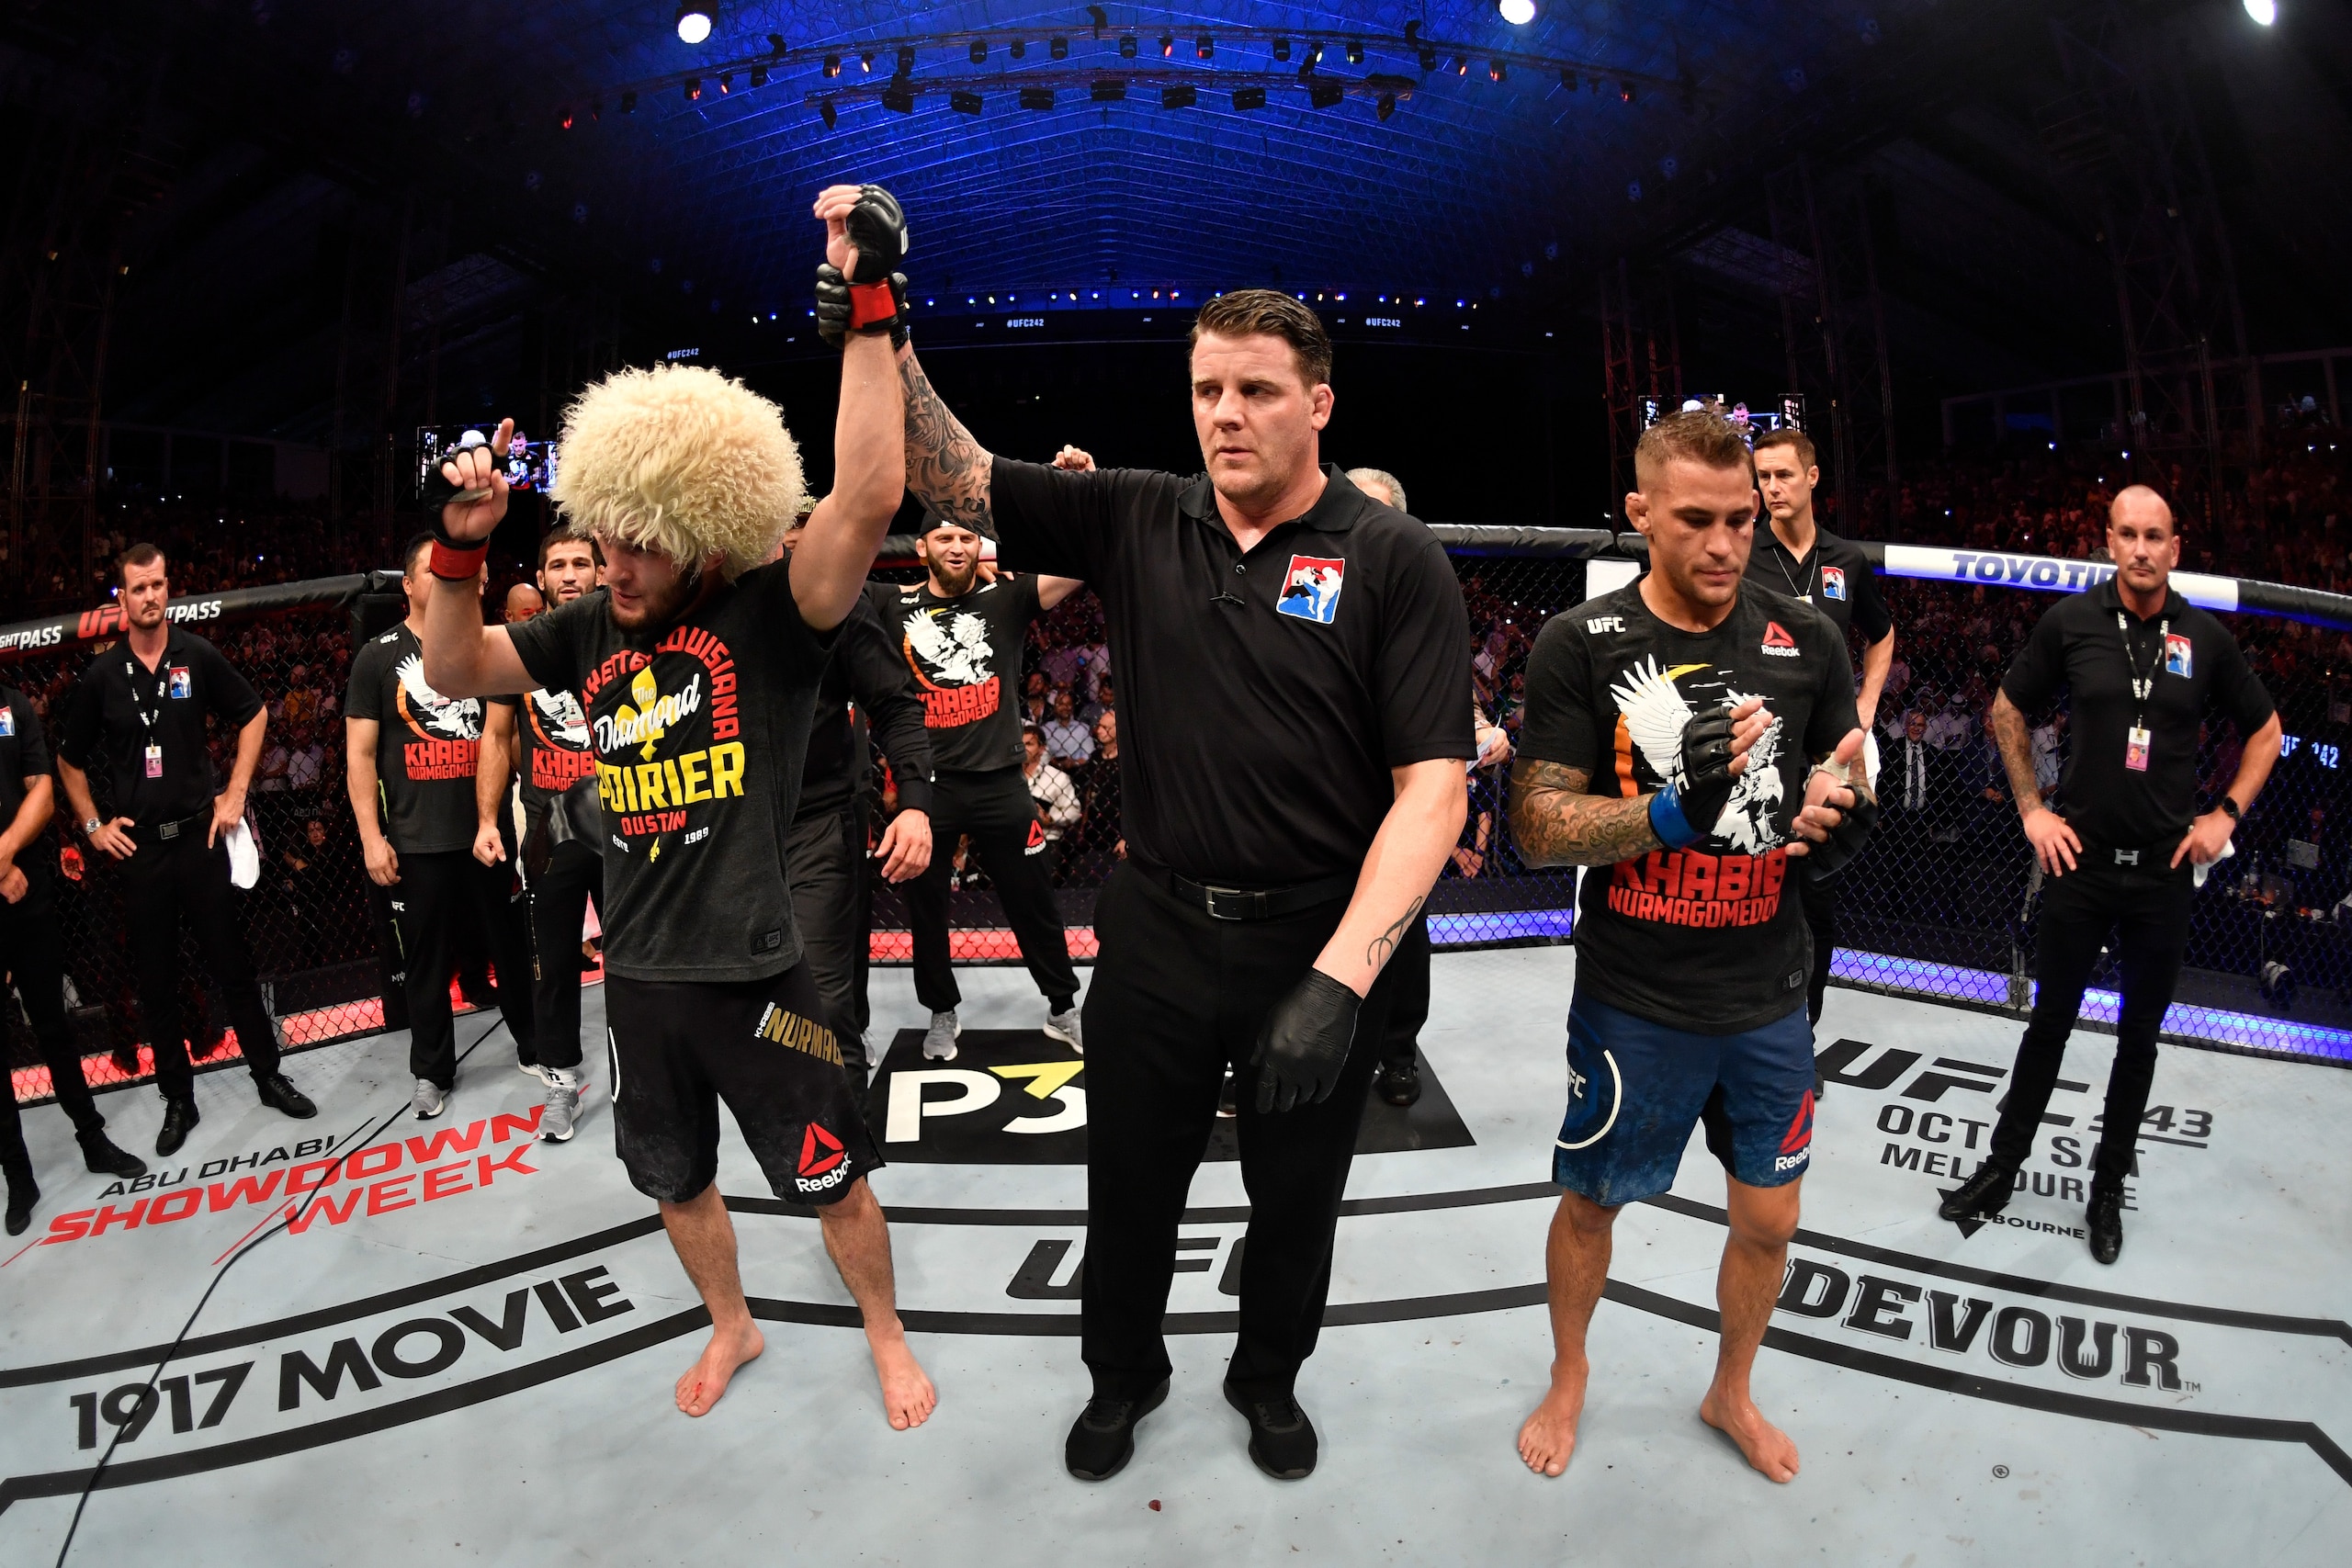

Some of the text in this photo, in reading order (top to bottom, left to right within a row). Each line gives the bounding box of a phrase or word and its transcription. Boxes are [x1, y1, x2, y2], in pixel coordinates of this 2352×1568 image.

[1007, 319, 1045, 328] #UFC242
[1365, 318, 1401, 327] #UFC242
[667, 347, 699, 360] #UFC242
[1952, 553, 2060, 586] TOYO
[1587, 616, 1626, 635] UFC
[1760, 644, 1801, 657] Reebok
[593, 672, 700, 754] Diamond
[634, 684, 655, 705] The
[594, 741, 745, 812] POIRIER
[621, 810, 687, 836] DUSTIN
[684, 827, 709, 844] 1989
[1612, 847, 1786, 902] KHABIB
[1608, 885, 1781, 929] NURMAGOMEDOV
[753, 1001, 776, 1039] KHABIB
[763, 1007, 845, 1069] NURMAG
[1567, 1065, 1586, 1099] FC
[1877, 1104, 1990, 1149] OCT
[39, 1104, 546, 1246] SHOWDOWN
[97, 1135, 334, 1200] ABU DHABI
[795, 1151, 852, 1193] Reebok
[284, 1143, 541, 1235] WEEK
[1777, 1257, 2182, 1393] DEVOUR
[71, 1266, 637, 1450] 1917 MOVIE
